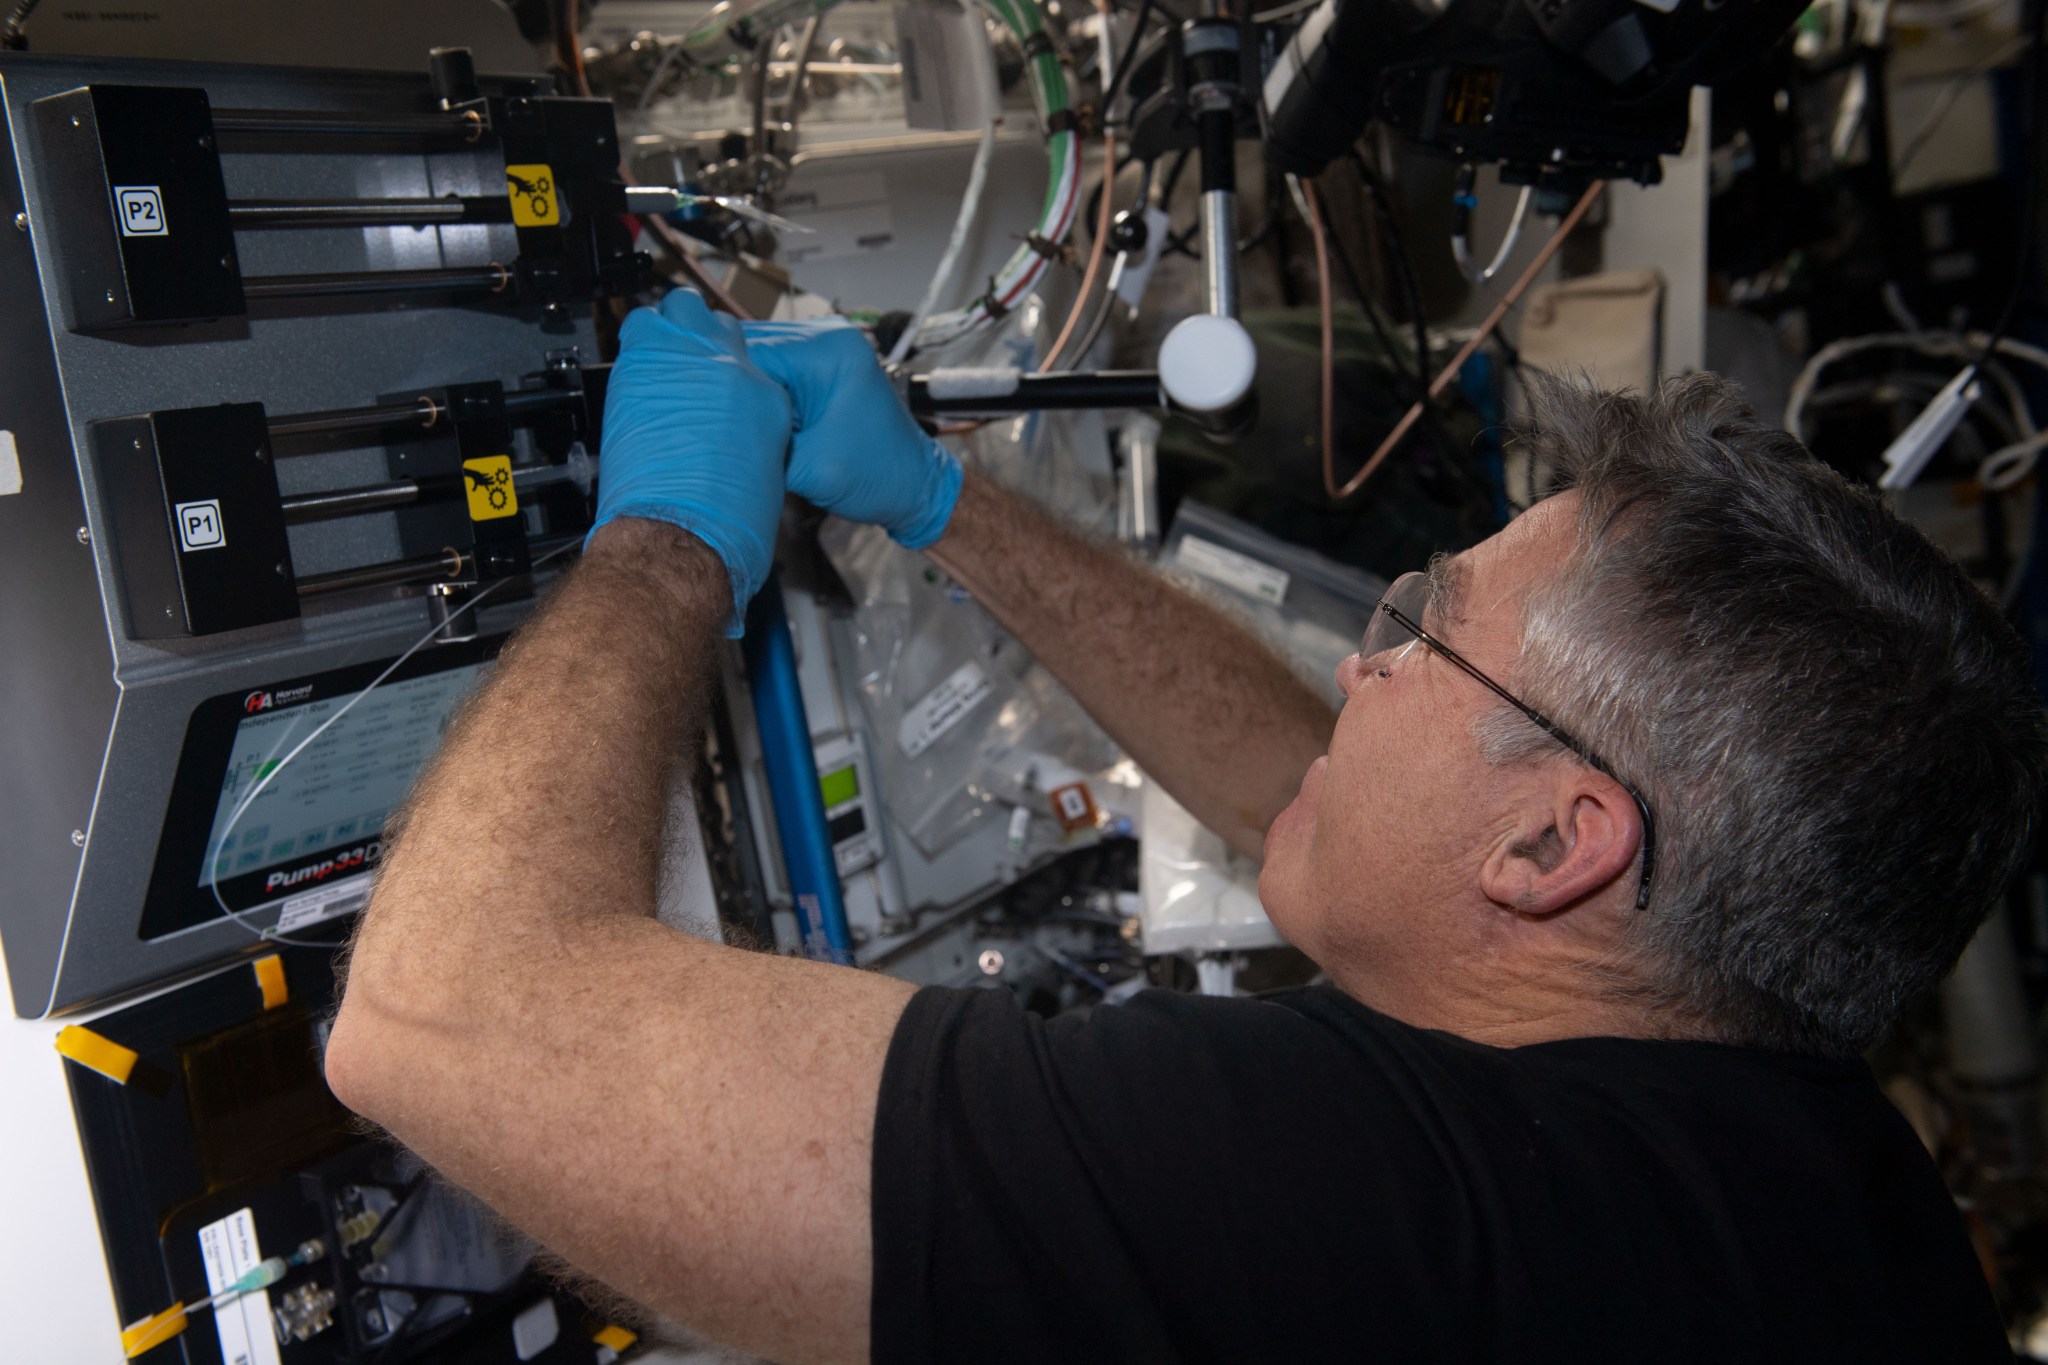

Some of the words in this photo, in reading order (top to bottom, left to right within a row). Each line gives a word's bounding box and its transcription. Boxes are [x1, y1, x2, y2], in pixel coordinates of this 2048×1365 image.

[128, 201, 156, 220] P2
[189, 515, 212, 535] P1
[275, 684, 314, 698] Harvard
[310, 703, 330, 713] Run
